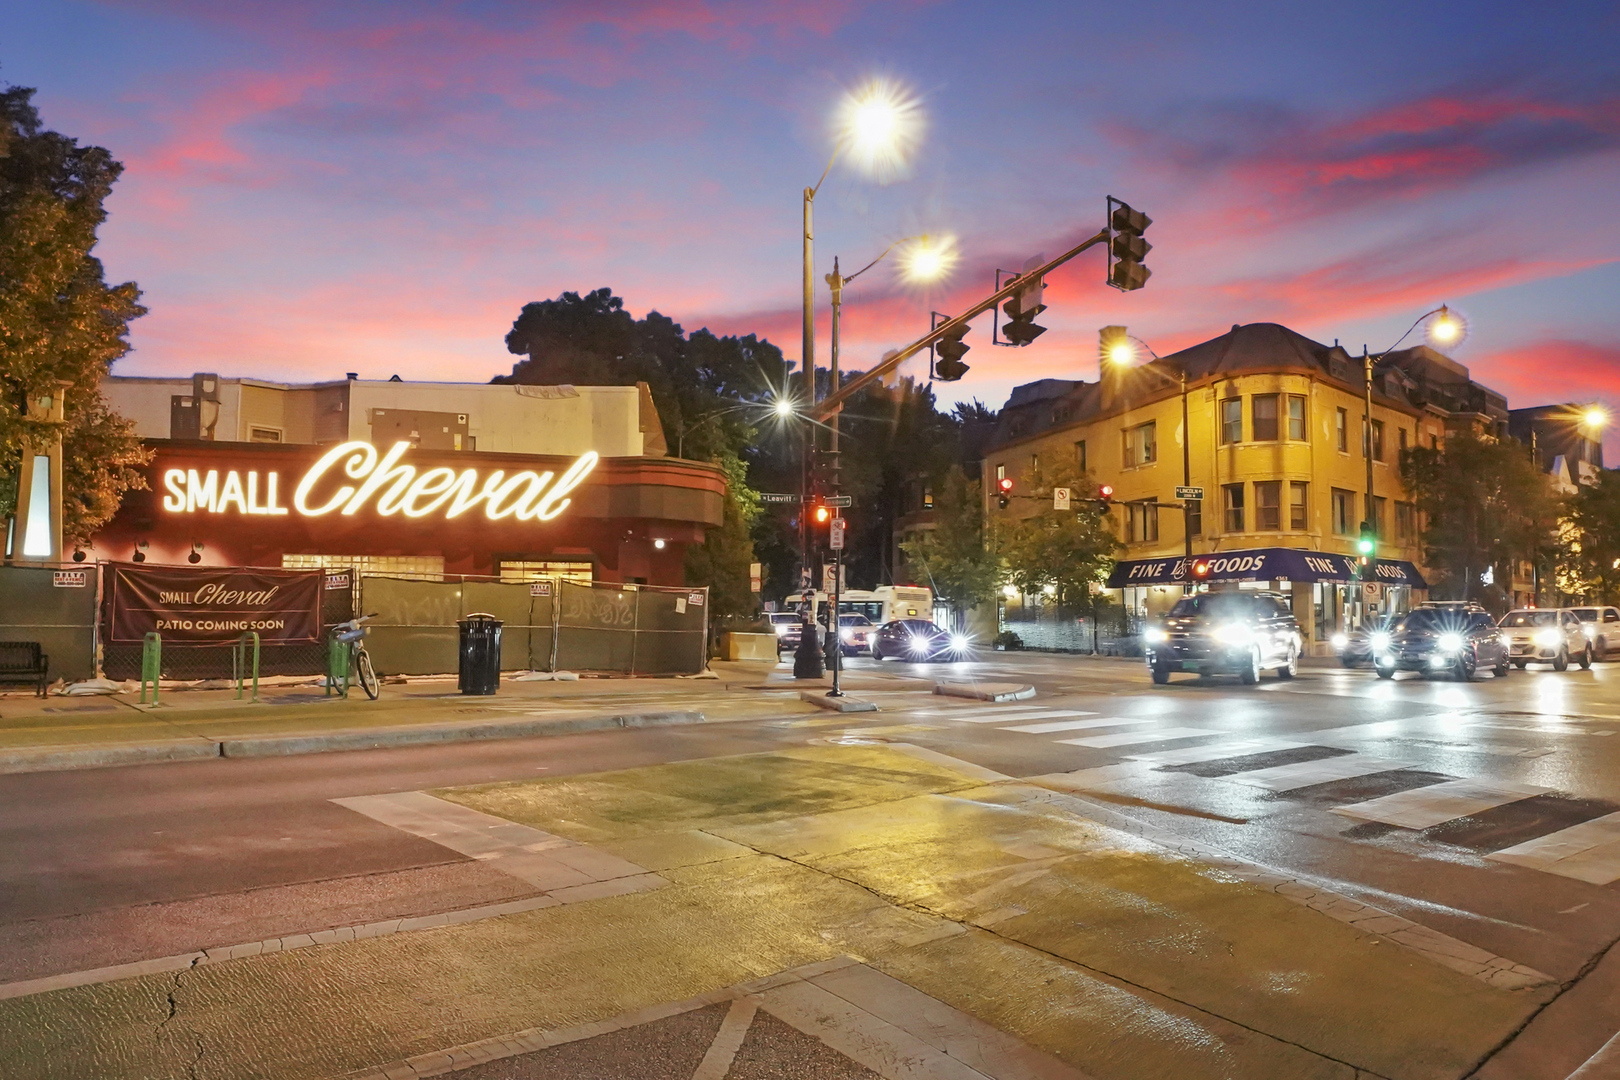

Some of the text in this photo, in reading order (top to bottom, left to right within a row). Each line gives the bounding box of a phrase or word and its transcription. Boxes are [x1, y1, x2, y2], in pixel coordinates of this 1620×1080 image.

[163, 440, 600, 521] SMALL Cheval
[1128, 563, 1167, 578] FINE
[1205, 555, 1266, 573] FOODS
[1304, 556, 1338, 574] FINE
[159, 583, 279, 605] SMALL Cheval
[156, 620, 284, 630] PATIO COMING SOON
